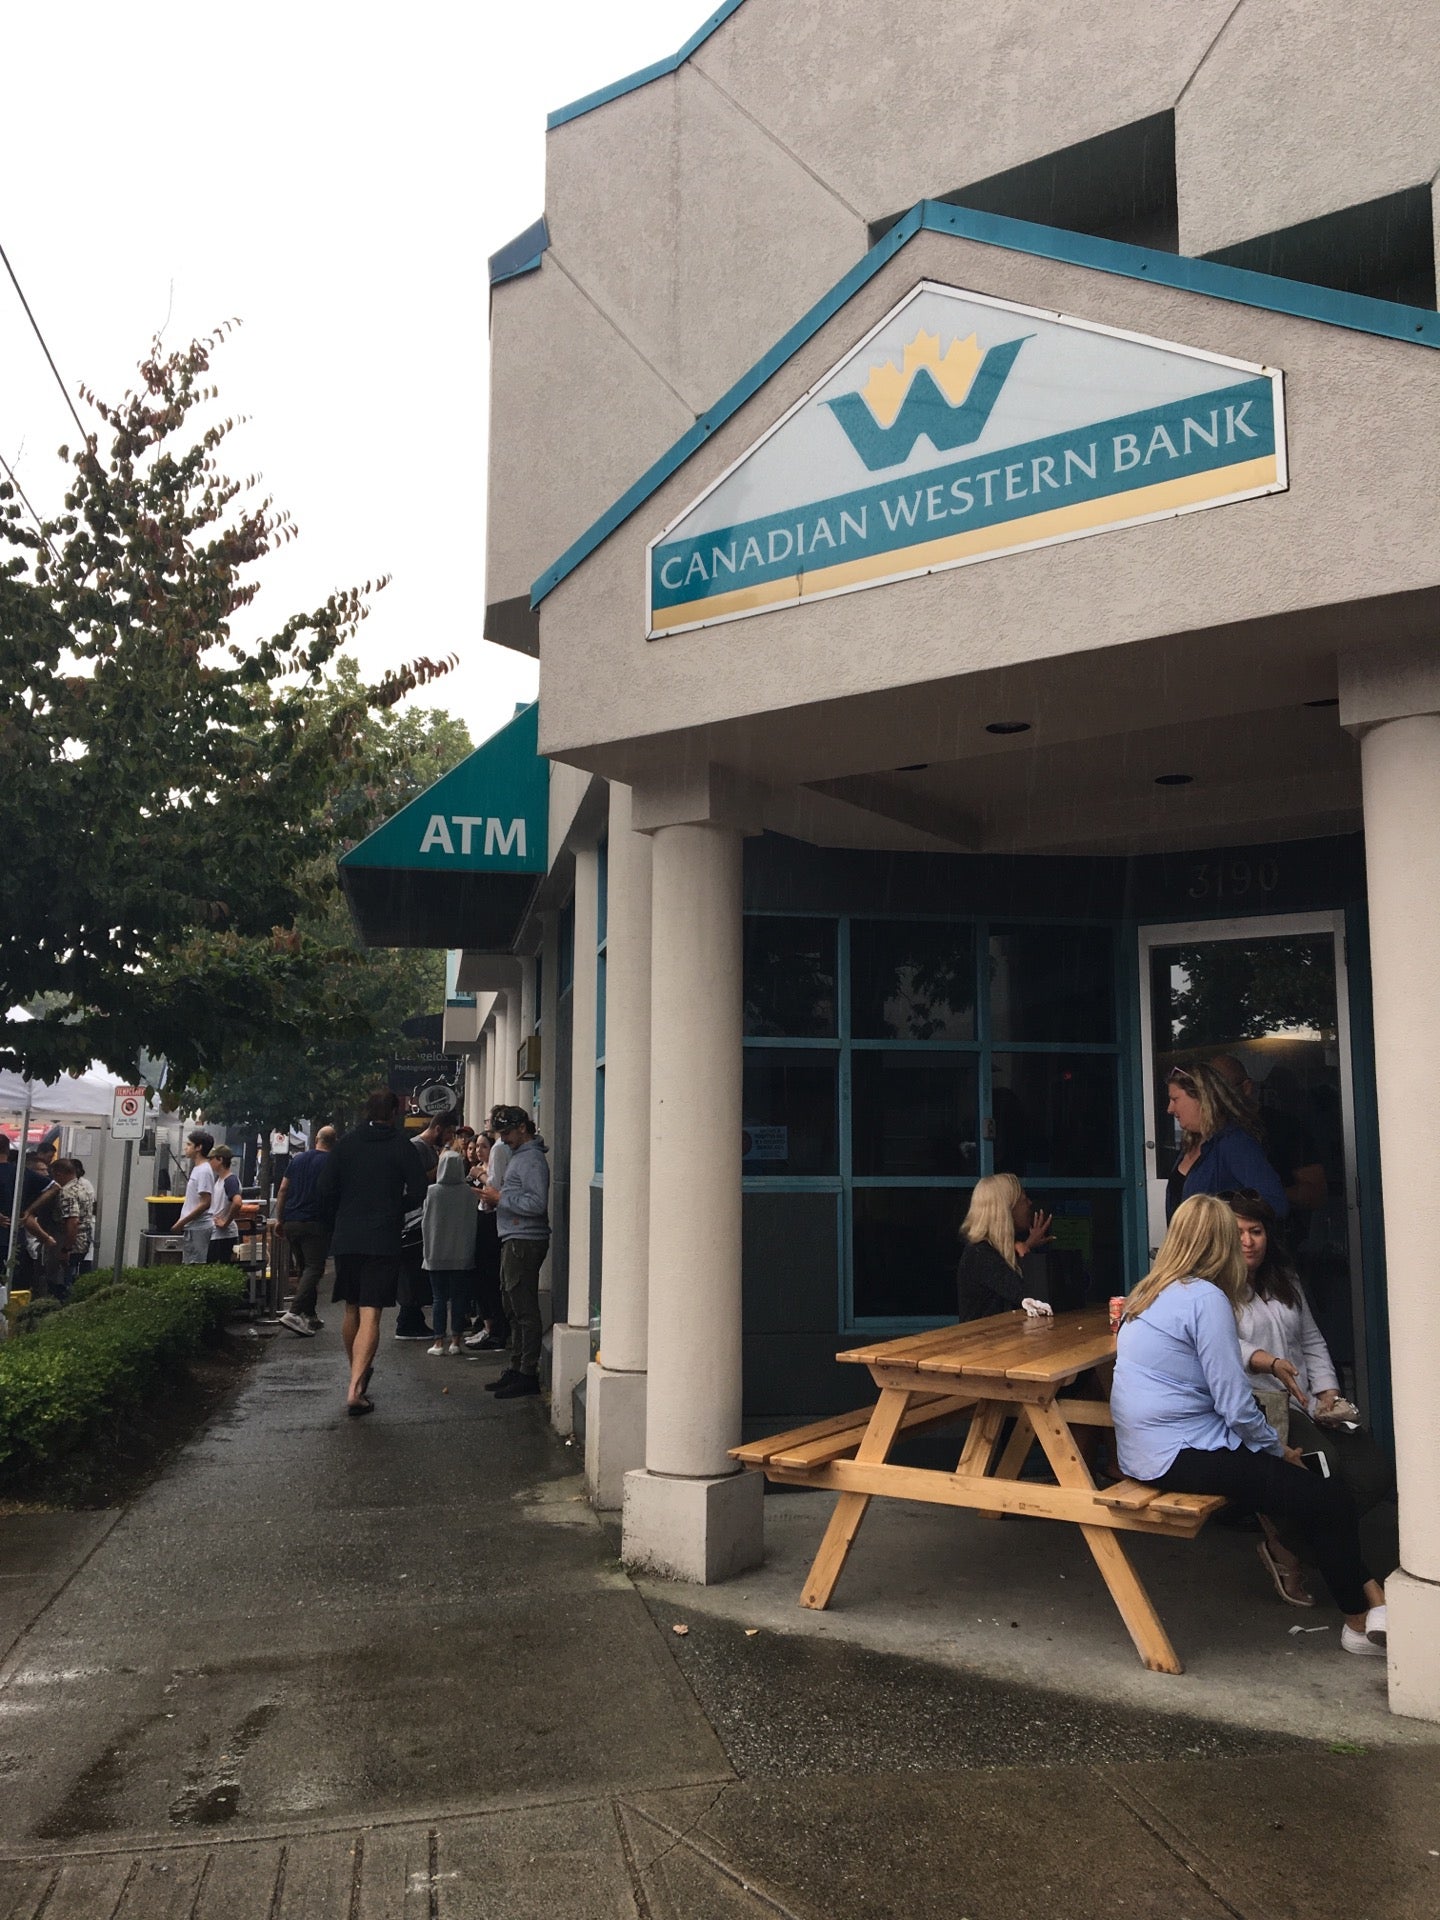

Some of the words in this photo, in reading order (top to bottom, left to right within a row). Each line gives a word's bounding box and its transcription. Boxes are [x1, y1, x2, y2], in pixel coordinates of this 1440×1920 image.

[660, 505, 868, 590] CANADIAN
[879, 442, 1097, 532] WESTERN
[1112, 400, 1259, 474] BANK
[418, 814, 527, 857] ATM
[1186, 859, 1280, 899] 3190
